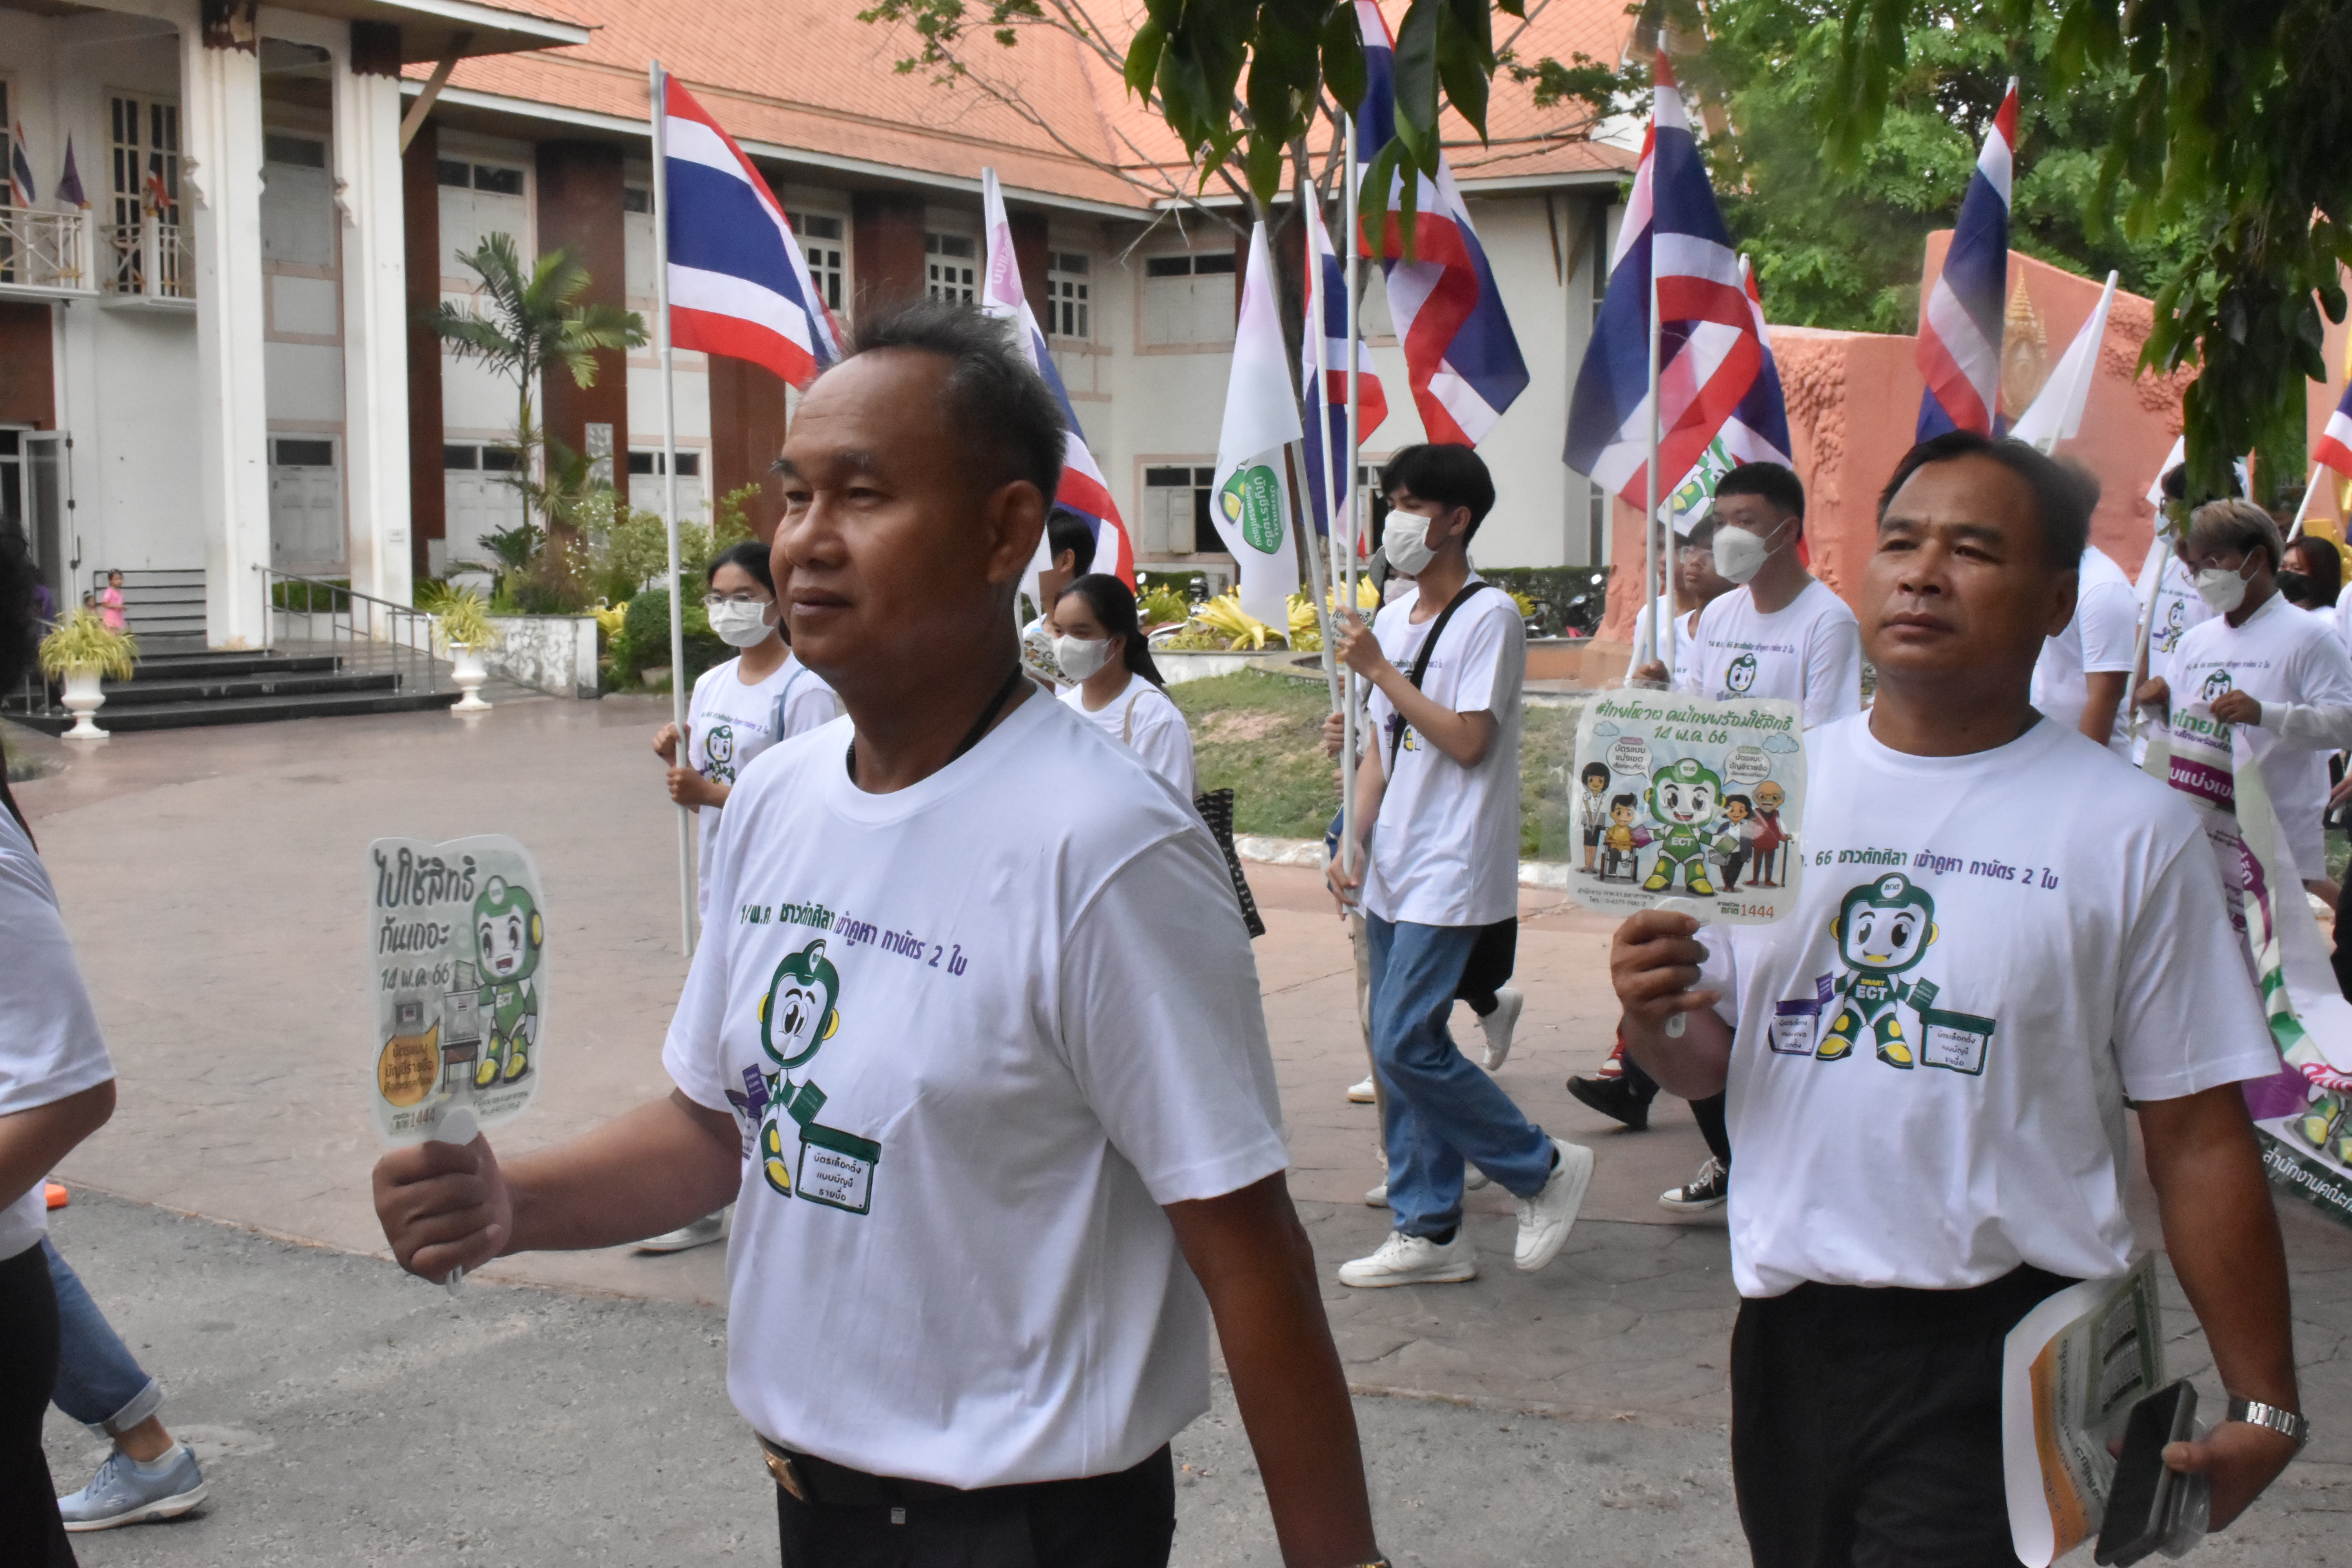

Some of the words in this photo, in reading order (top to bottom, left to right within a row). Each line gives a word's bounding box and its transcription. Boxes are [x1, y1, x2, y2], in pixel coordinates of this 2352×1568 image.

[1254, 476, 1275, 548] บัญชีรายชื่อ
[1654, 725, 1673, 740] 14
[1675, 729, 1703, 742] พ.ค.
[1708, 730, 1728, 744] 66
[1615, 744, 1646, 754] บัตรแบบ
[1671, 836, 1693, 847] ECT
[1815, 850, 1833, 866] 66
[1838, 847, 1908, 866] ชาวตักศิลา
[1913, 849, 1963, 875] เข้าคูหา
[1969, 859, 2016, 881] กาบัตร
[2021, 868, 2034, 885] 2
[2040, 867, 2059, 890] ใบ
[1741, 904, 1774, 919] 1444
[881, 930, 926, 960] กาบัตร
[928, 945, 943, 967] 2
[947, 944, 968, 976] ใบ
[432, 962, 450, 986] 66
[1855, 984, 1888, 1001] ECT
[410, 1107, 435, 1128] 1444
[814, 1152, 862, 1174] บัตรเลือกตั้ง
[817, 1172, 853, 1188] แบบบัญชี
[2263, 1147, 2352, 1213] สำนักงานคณะก
[819, 1187, 846, 1201] รายชื่อ
